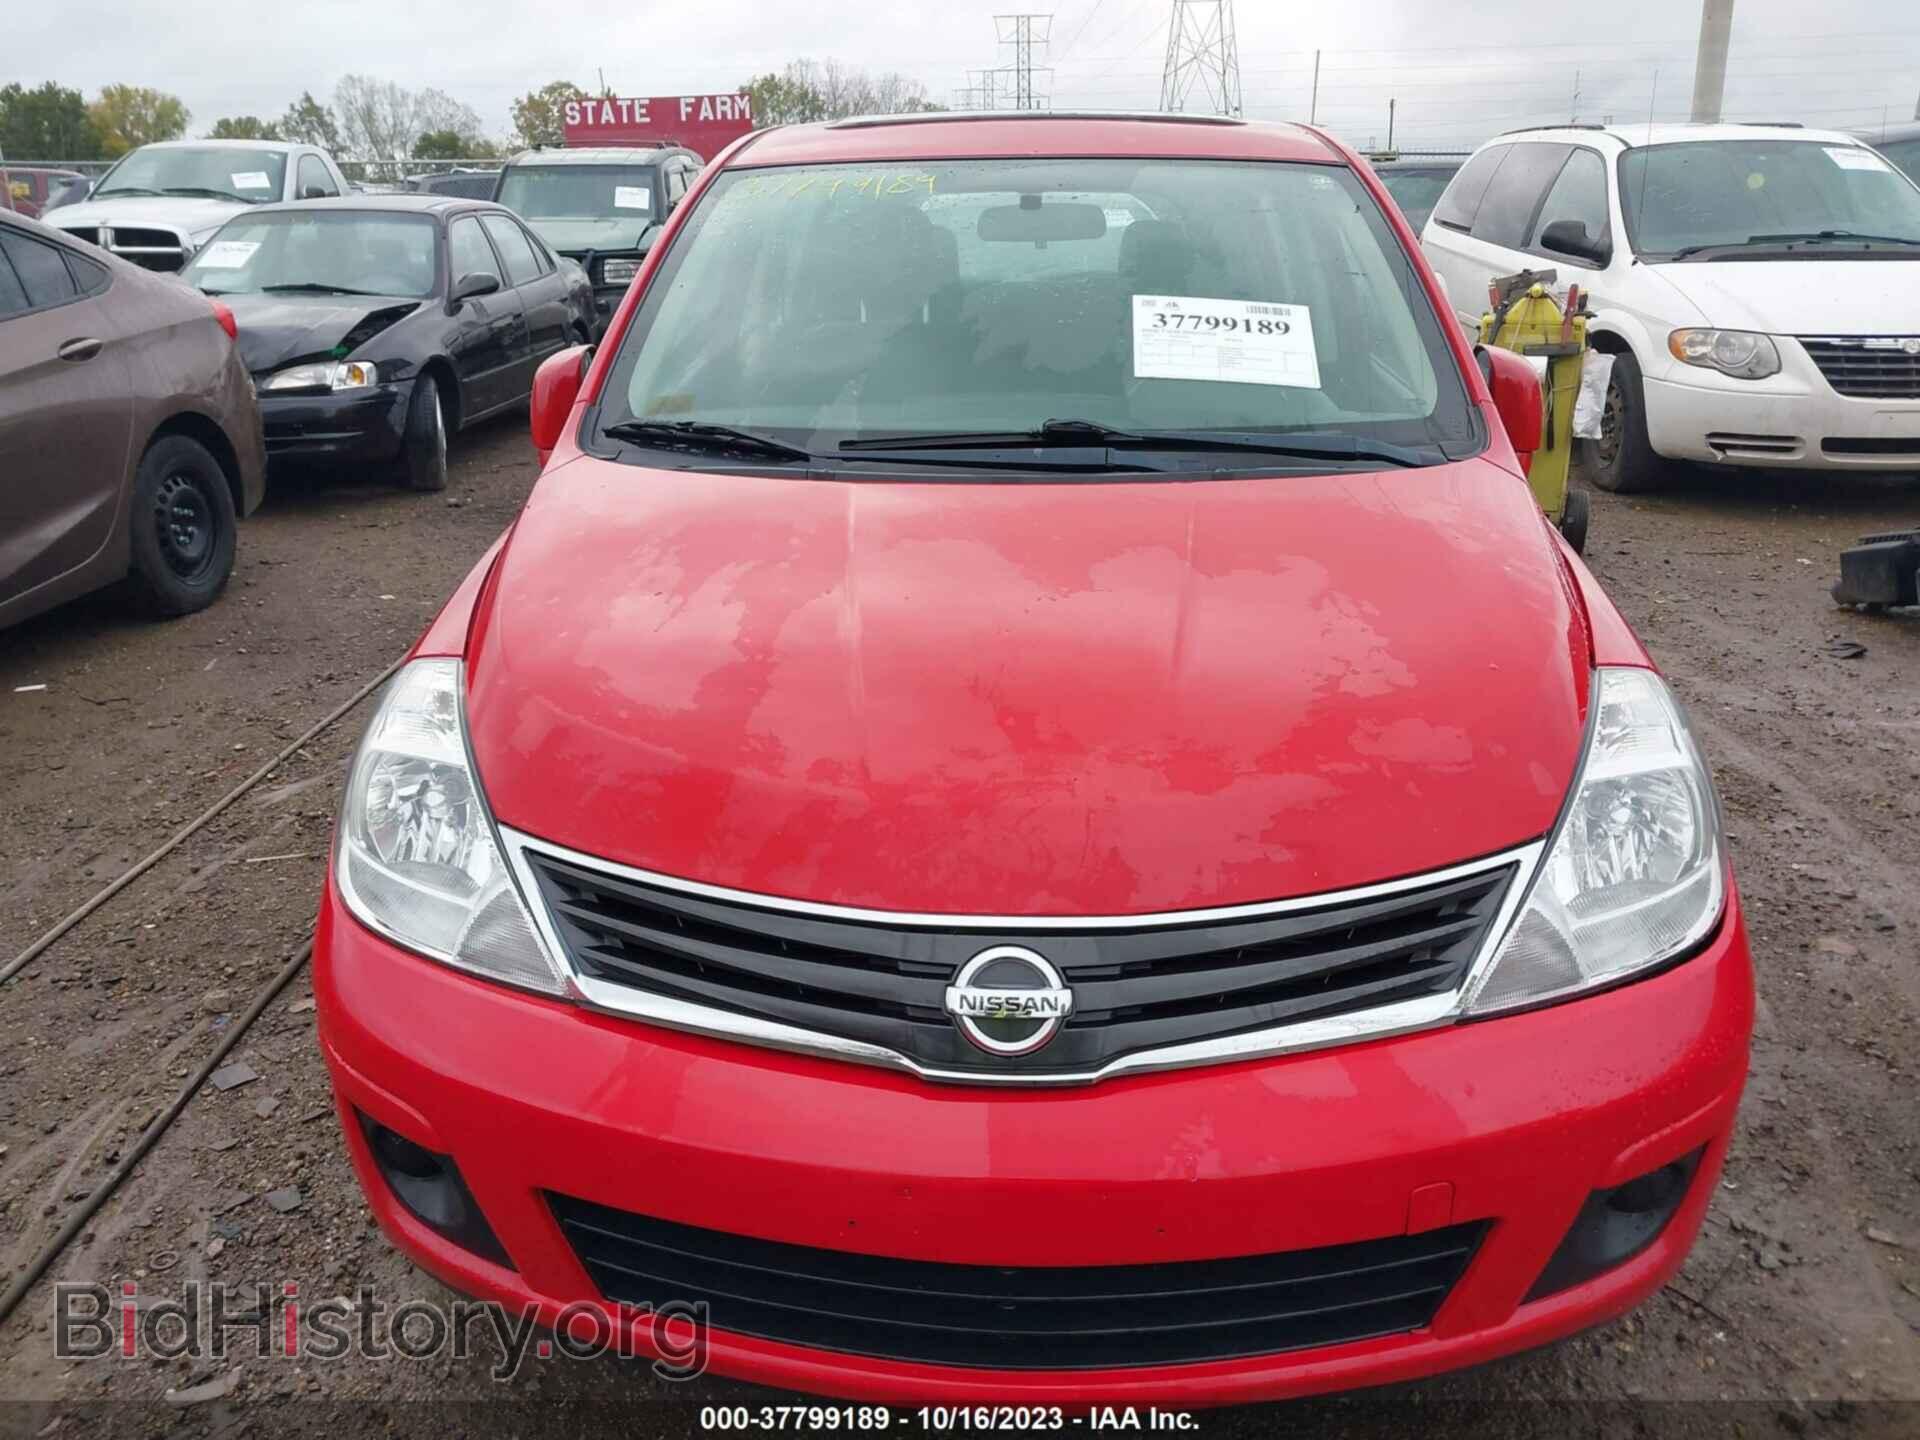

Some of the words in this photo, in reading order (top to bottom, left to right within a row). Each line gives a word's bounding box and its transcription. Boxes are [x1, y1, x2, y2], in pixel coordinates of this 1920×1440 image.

[565, 99, 650, 125] STATE
[680, 95, 750, 121] FARM
[1152, 312, 1291, 335] 37799189
[959, 994, 1059, 1013] NISSAN
